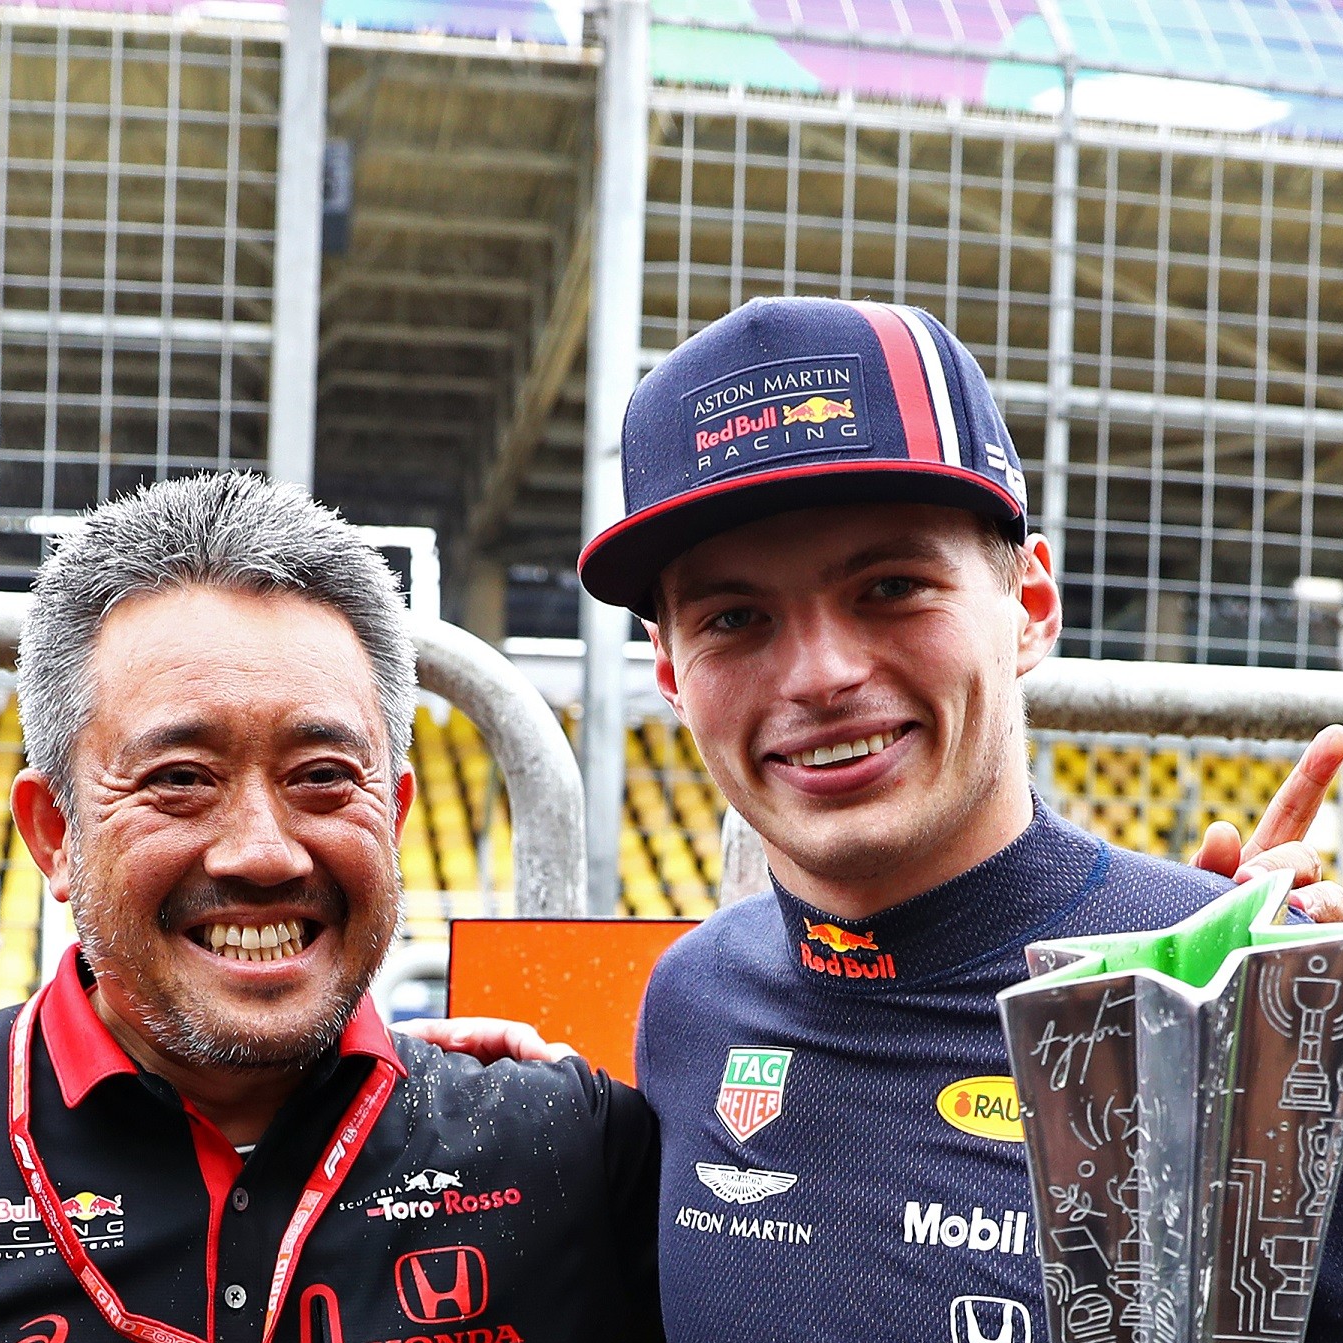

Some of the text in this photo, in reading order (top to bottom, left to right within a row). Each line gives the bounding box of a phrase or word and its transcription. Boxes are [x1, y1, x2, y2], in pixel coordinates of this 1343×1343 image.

[694, 368, 850, 418] ASTON MARTIN
[695, 406, 777, 452] Red Bull
[697, 424, 857, 471] RACING
[800, 941, 896, 979] Red Bull
[731, 1055, 783, 1083] TAG
[721, 1090, 778, 1131] HEUER
[377, 1187, 522, 1221] Toro Rosso
[82, 1240, 124, 1250] EAM
[675, 1206, 812, 1245] ASTON MARTIN
[904, 1201, 1027, 1255] Mobil
[97, 1289, 137, 1333] GRID
